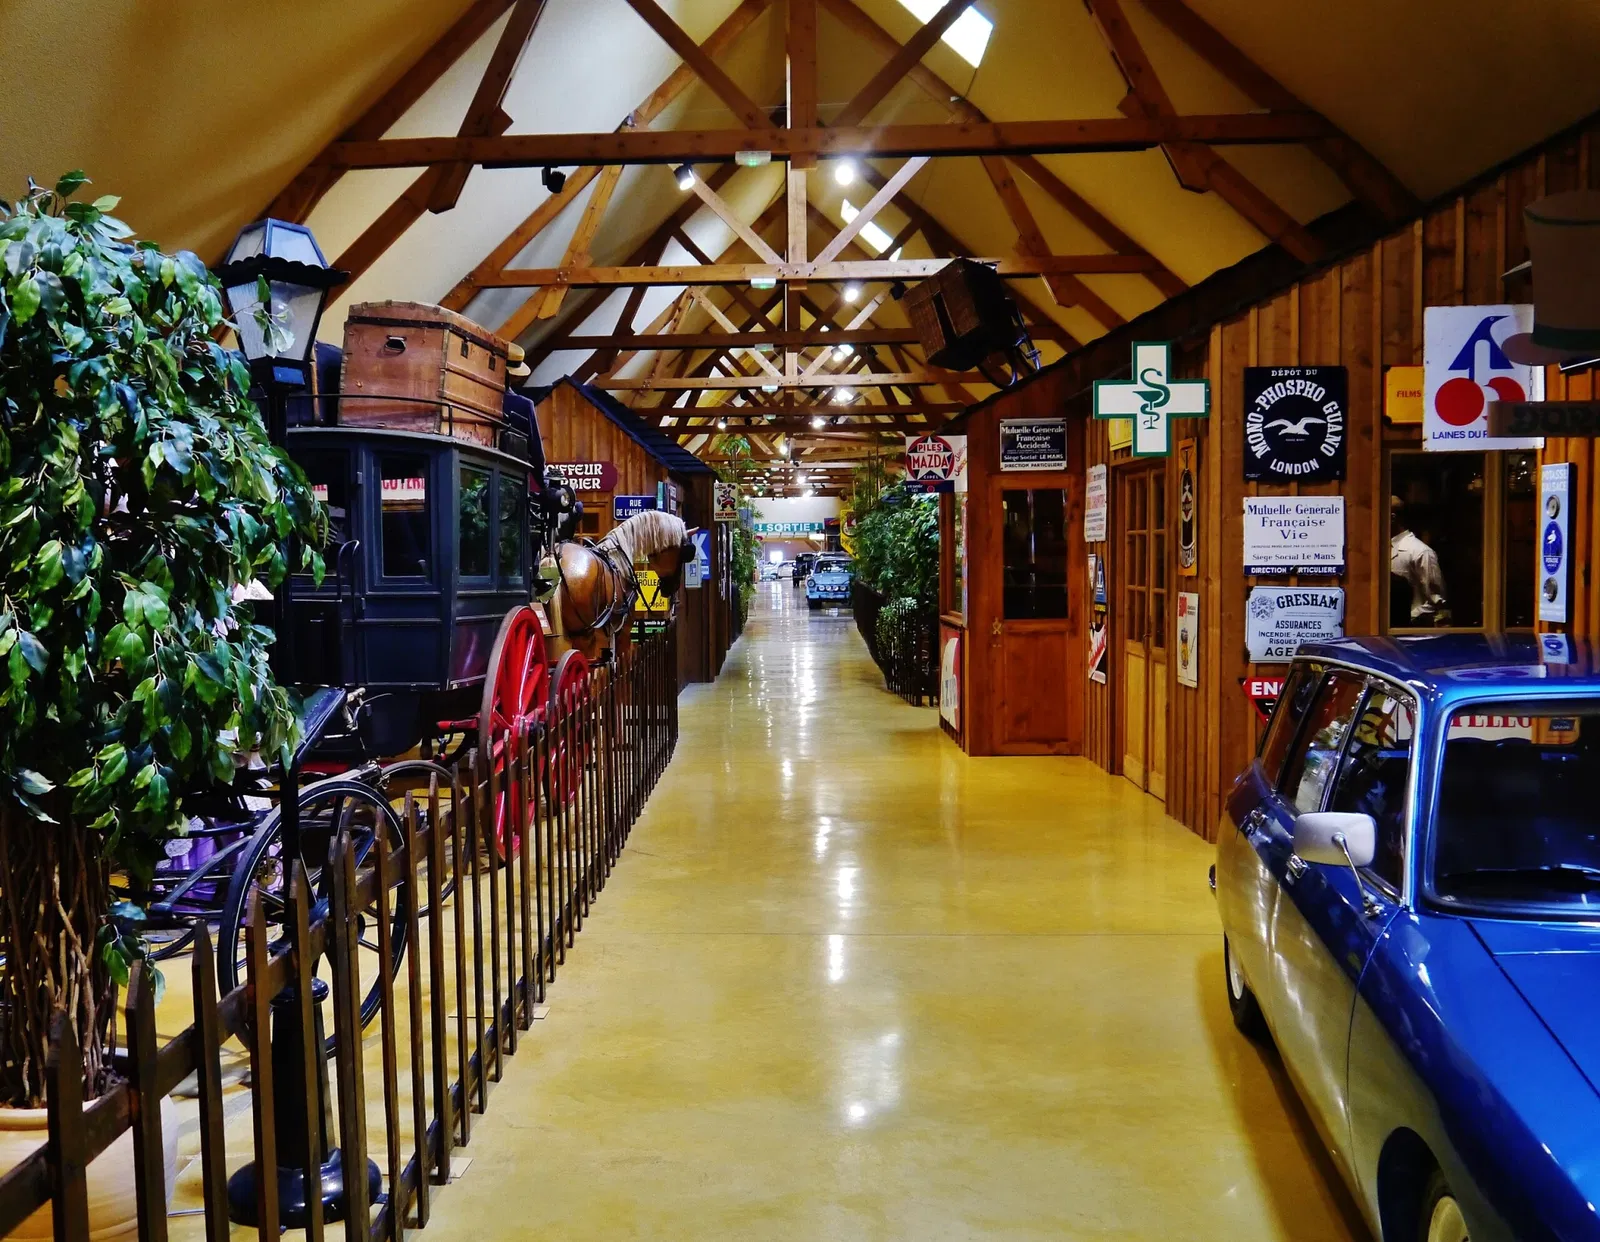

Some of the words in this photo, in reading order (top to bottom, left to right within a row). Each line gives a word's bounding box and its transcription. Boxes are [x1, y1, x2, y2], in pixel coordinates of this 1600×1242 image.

[1396, 390, 1422, 398] FILMS
[1320, 401, 1343, 457] GUANO
[1432, 431, 1466, 440] LAINES
[1468, 431, 1482, 439] DU
[918, 443, 942, 452] PILES
[1016, 441, 1051, 449] Accidents
[912, 453, 949, 469] MAZDA
[1270, 458, 1319, 475] LONDON
[629, 499, 642, 507] RUE
[616, 508, 623, 516] DE
[1248, 504, 1292, 515] Mutuelle
[766, 523, 811, 531] SORTIE
[1261, 516, 1326, 528] Française
[1280, 529, 1308, 540] Vie
[1276, 593, 1339, 610] GRESHAM
[1275, 620, 1322, 630] ASSURANCES
[1269, 637, 1298, 645] RISQUES
[1264, 647, 1295, 657] AGE
